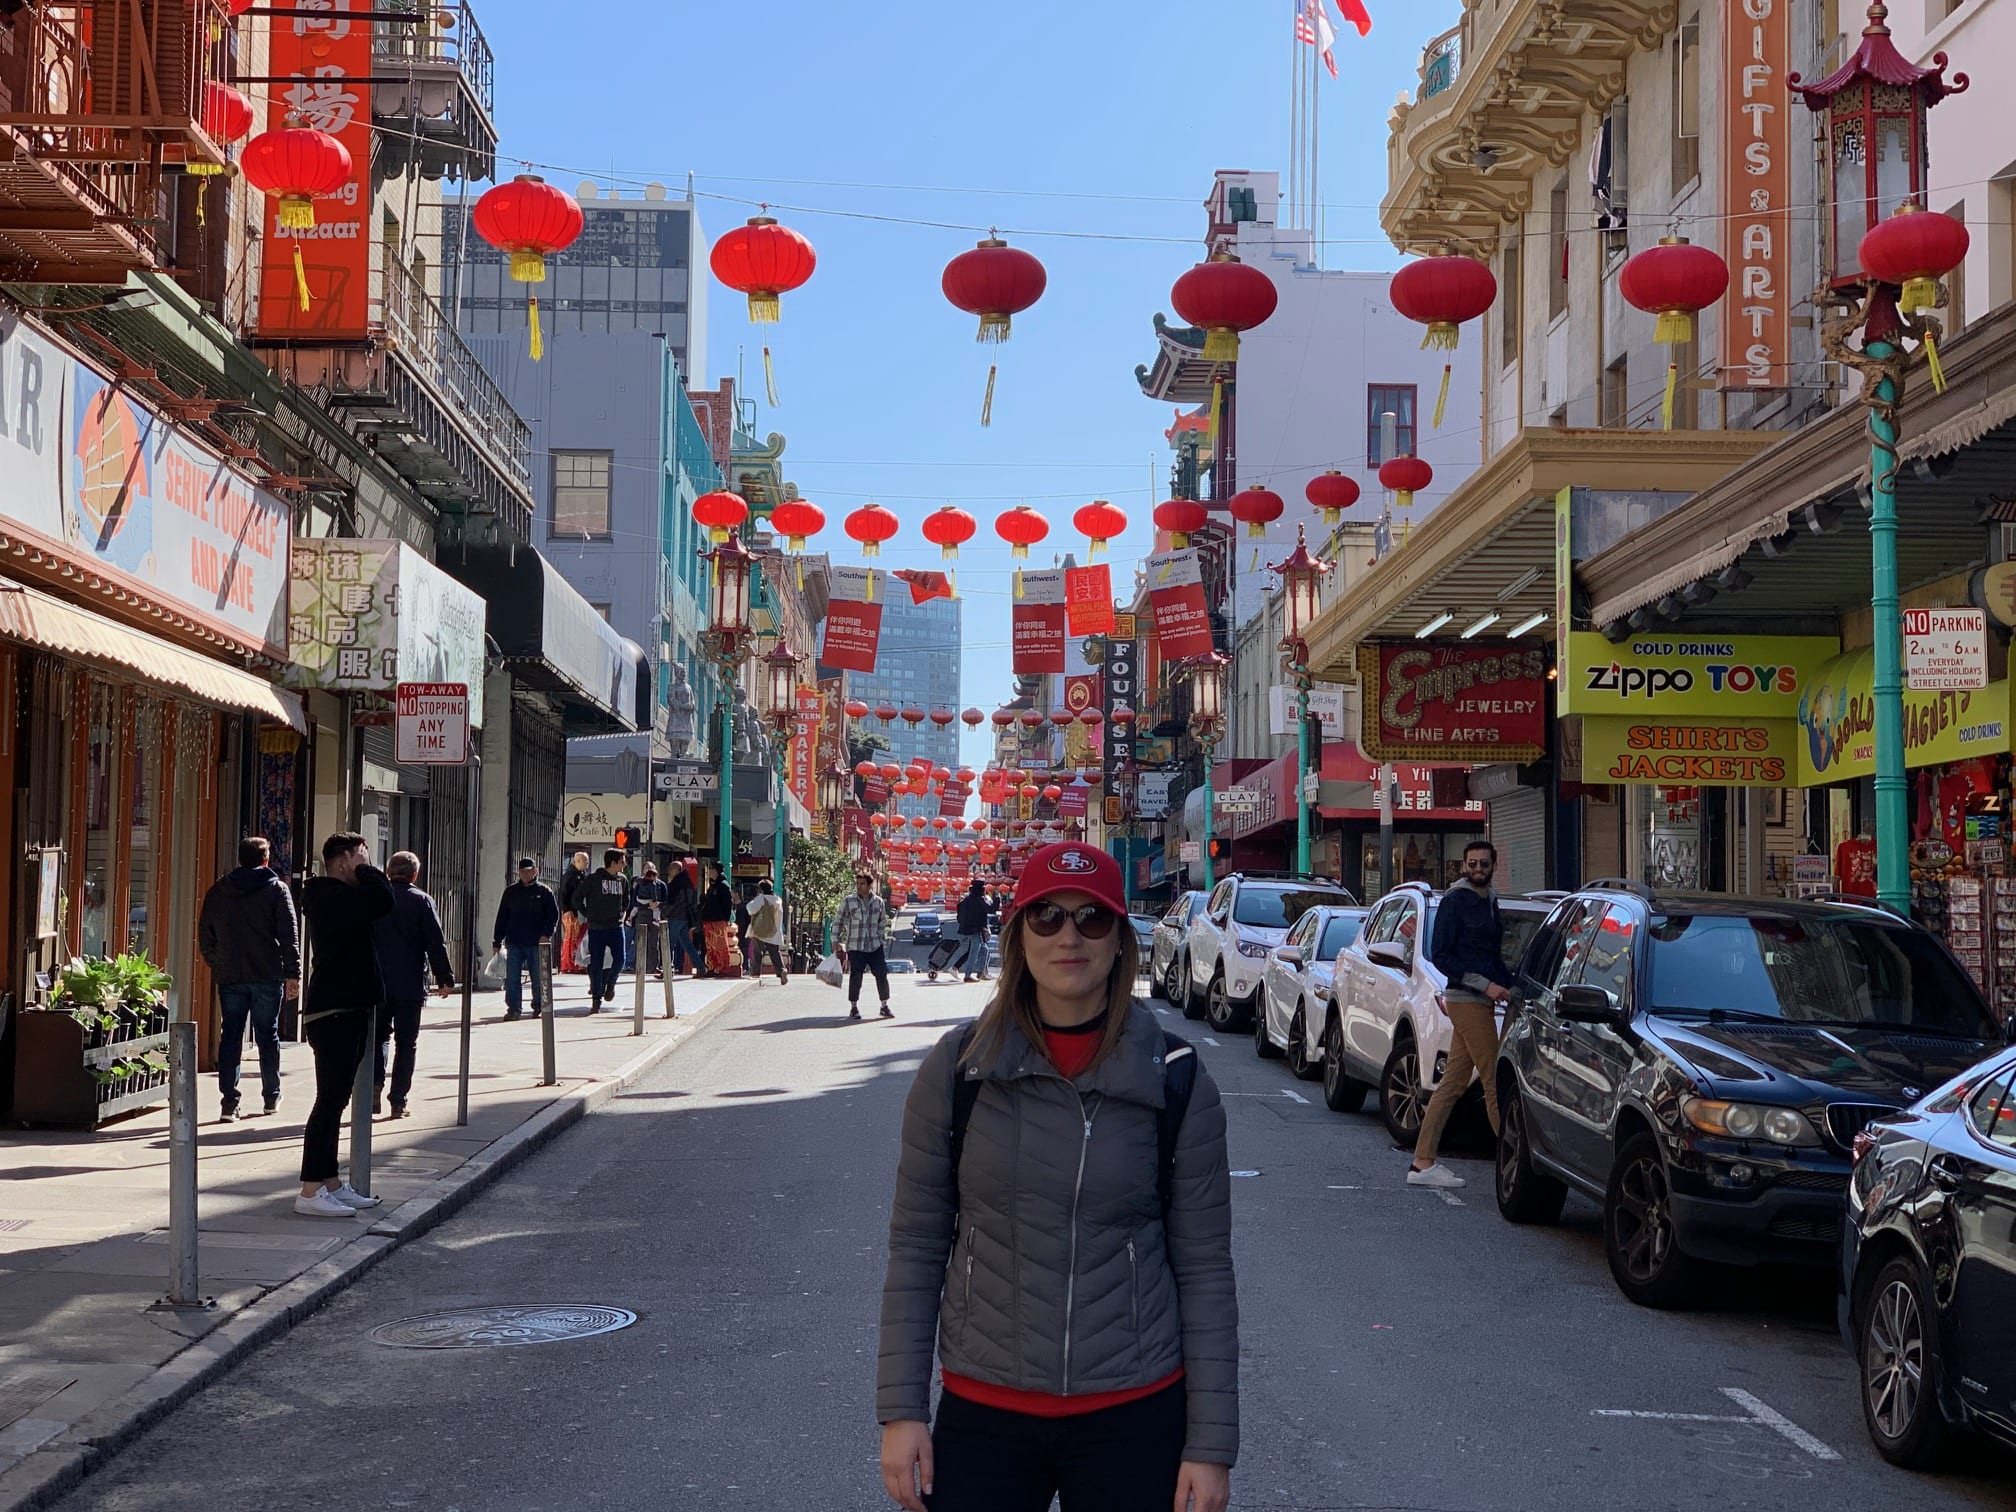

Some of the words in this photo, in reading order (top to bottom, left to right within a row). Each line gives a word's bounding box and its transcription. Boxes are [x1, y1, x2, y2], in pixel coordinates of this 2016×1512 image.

[1742, 0, 1775, 175] GIFTS
[1750, 189, 1769, 210] &
[1742, 224, 1775, 372] ARTS
[165, 448, 208, 522] SERVE
[214, 486, 278, 560] YOURSELF
[191, 537, 218, 592] AND
[220, 550, 254, 614] SAVE
[838, 572, 878, 580] Southwt
[1906, 613, 1927, 632] NO
[1932, 616, 1982, 632] PARKING
[1633, 643, 1673, 656] COLD
[1678, 642, 1734, 656] DRINKS
[1910, 641, 1919, 654] 2
[1955, 641, 1963, 654] 6
[1112, 644, 1130, 711] FOUR
[1706, 664, 1797, 695] TOYS
[402, 685, 462, 694] TOW-AWAY
[1382, 650, 1544, 728] Empress
[400, 697, 417, 715] NO
[419, 702, 463, 715] STOPPING
[1456, 700, 1536, 714] JEWELRY
[419, 719, 445, 732] ANY
[1451, 728, 1500, 741] ARTS
[1960, 728, 1976, 743] COLD
[1978, 722, 2001, 739] DRINKS
[416, 735, 446, 748] TIME
[1628, 726, 1768, 751] SHIRTS
[796, 724, 808, 802] BAKERY
[1609, 755, 1785, 781] JACKETS
[664, 777, 712, 786] CLAY
[1370, 768, 1398, 784] Jig
